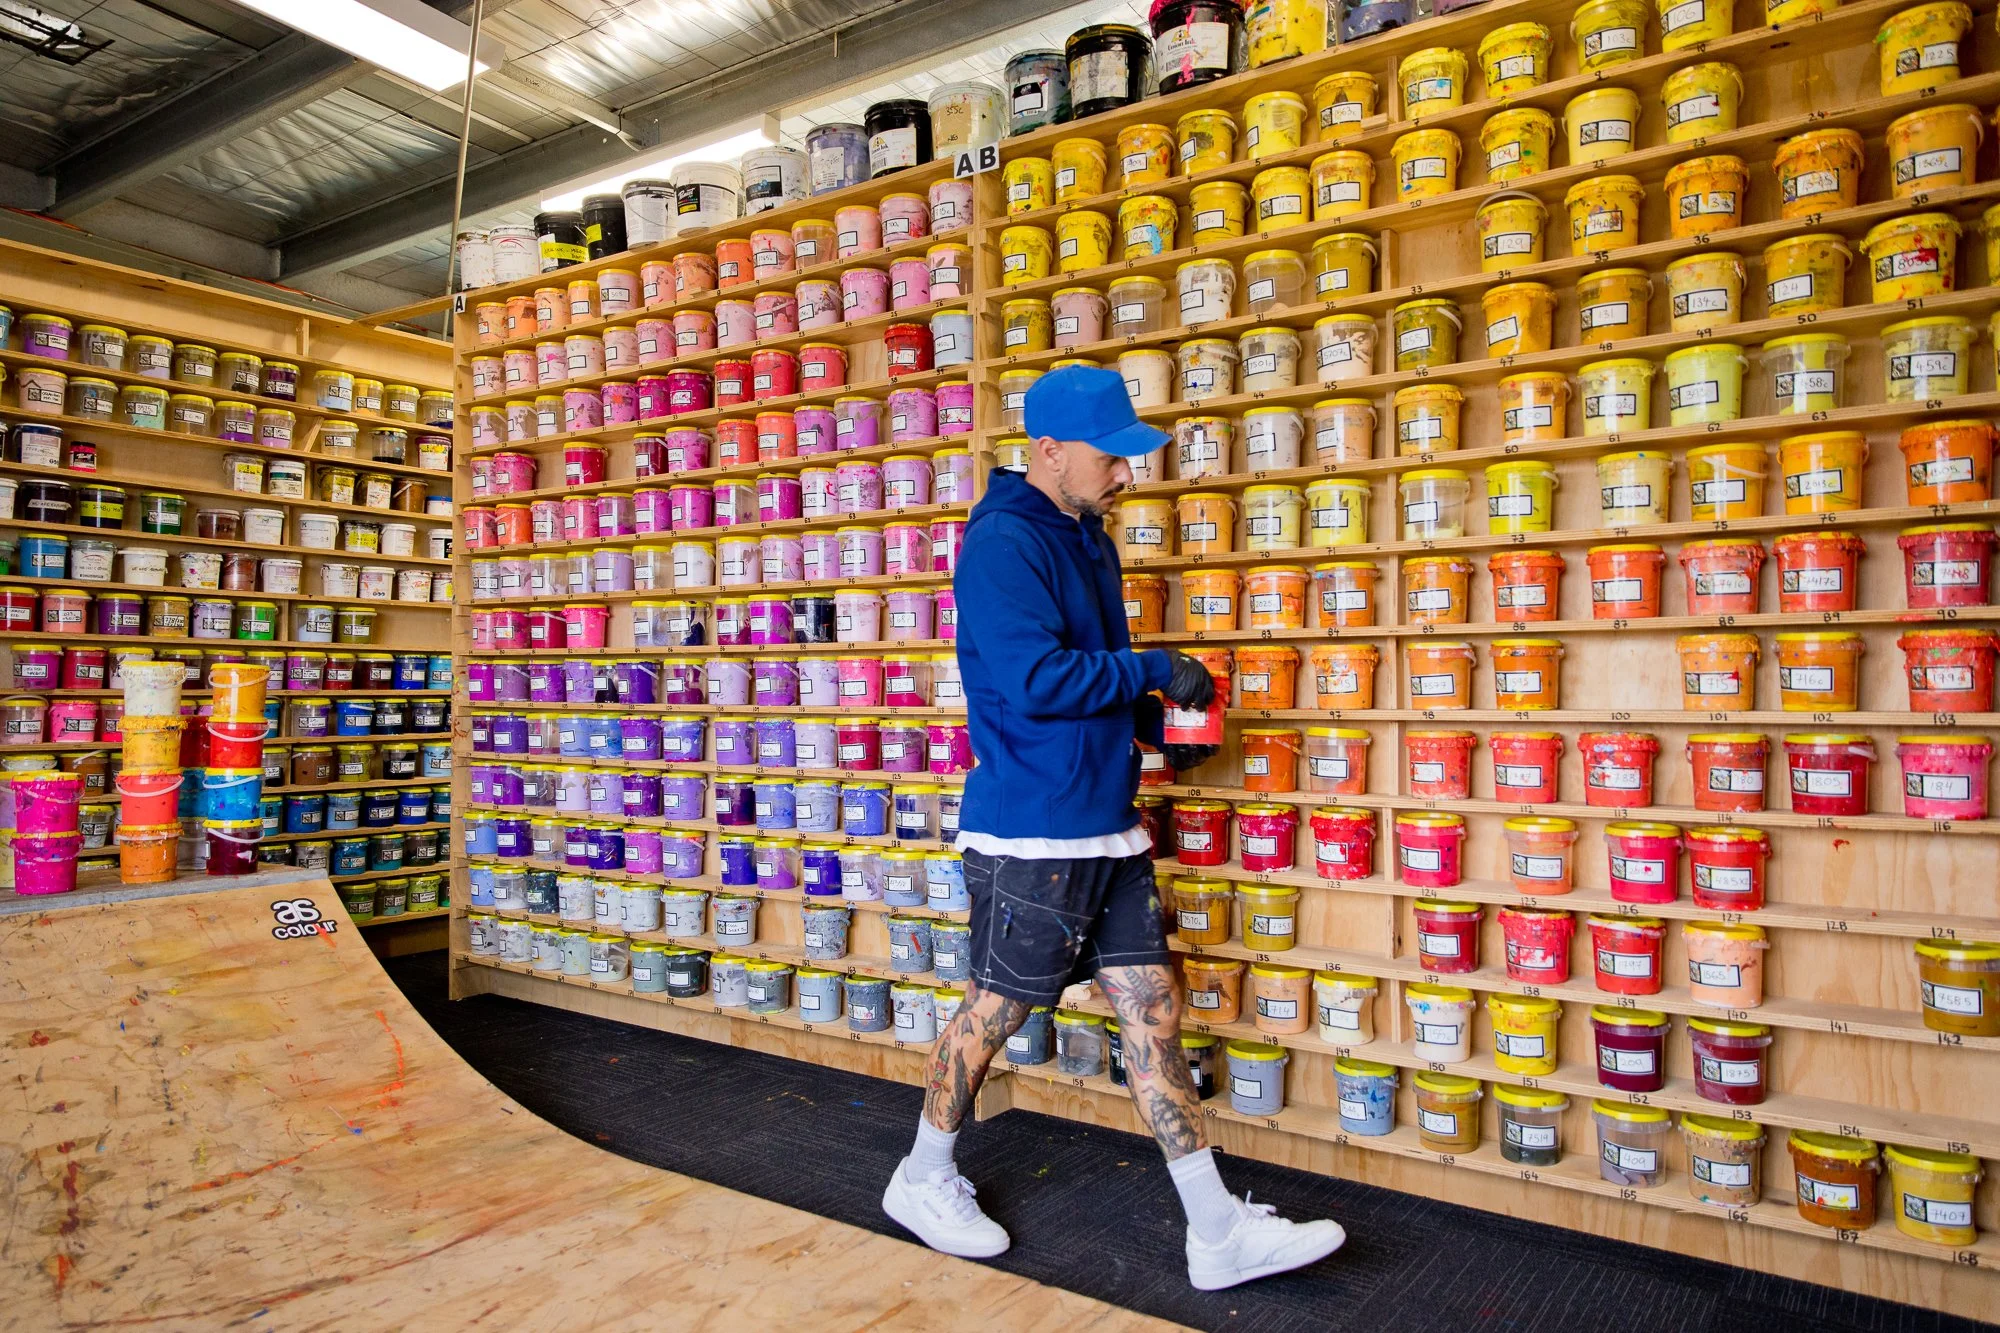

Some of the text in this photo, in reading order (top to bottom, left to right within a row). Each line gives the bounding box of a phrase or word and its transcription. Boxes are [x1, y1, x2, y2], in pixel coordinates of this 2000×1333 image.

[1815, 13, 1823, 22] 11
[1920, 87, 1936, 98] 25
[1809, 111, 1825, 122] 24
[1602, 125, 1624, 137] 120
[1693, 137, 1706, 147] 23
[980, 146, 996, 170] B
[956, 153, 974, 177] A
[1594, 160, 1606, 168] 22
[1410, 200, 1421, 208] 20
[1912, 194, 1928, 207] 38
[1805, 214, 1821, 226] 37
[1694, 234, 1710, 245] 36
[1594, 252, 1609, 261] 35
[1498, 270, 1511, 278] 34
[1411, 286, 1423, 294] 33
[1776, 283, 1798, 297] 124
[455, 296, 463, 312] A
[1326, 301, 1336, 310] 32
[1692, 297, 1718, 308] 134c
[1907, 299, 1923, 310] 51
[1797, 313, 1817, 324] 50
[1696, 328, 1712, 338] 49
[1599, 343, 1613, 351] 48
[1500, 357, 1514, 366] 47
[1416, 369, 1428, 377] 46
[1324, 381, 1338, 390] 45
[1926, 400, 1943, 409] 64
[1812, 412, 1828, 421] 63
[1707, 423, 1720, 432] 62
[1505, 445, 1519, 454] 60
[1421, 455, 1434, 463] 59
[1324, 465, 1337, 473] 58
[1931, 504, 1950, 516] 77
[1819, 513, 1836, 523] 76
[1712, 521, 1728, 530] 75
[1614, 528, 1628, 537] 74
[1512, 535, 1525, 543] 73
[1421, 541, 1435, 549] 72
[1326, 547, 1336, 555] 71
[1823, 613, 1840, 623] 89
[1937, 609, 1957, 619] 90
[1614, 620, 1628, 630] 87
[1719, 616, 1735, 626] 88
[1423, 625, 1434, 633] 85
[1513, 622, 1526, 631] 86
[1261, 630, 1272, 639] 83
[1327, 628, 1340, 637] 84
[1706, 678, 1729, 691] 715
[1260, 710, 1271, 718] 96
[1330, 711, 1342, 720] 97
[1422, 711, 1435, 720] 98
[1516, 711, 1529, 720] 99
[1611, 711, 1630, 721] 100
[1710, 712, 1728, 722] 101
[1813, 713, 1834, 722] 102
[1934, 714, 1956, 725] 103
[1187, 789, 1201, 797] 108
[1255, 792, 1268, 800] 109
[1325, 796, 1337, 804] 110
[1520, 805, 1534, 813] 112
[1613, 808, 1628, 818] 113
[1717, 814, 1733, 824] 114
[1818, 817, 1833, 827] 115
[1934, 821, 1951, 832] 116
[1187, 867, 1198, 875] 121
[1256, 874, 1270, 882] 122
[1327, 880, 1341, 889] 123
[1421, 888, 1437, 898] 124
[1520, 897, 1537, 906] 125
[271, 898, 321, 924] as
[1617, 904, 1638, 915] 126
[1722, 913, 1743, 923] 127
[1826, 921, 1848, 931] 128
[1932, 926, 1955, 938] 129
[1191, 945, 1203, 954] 134
[1256, 953, 1270, 962] 135
[801, 959, 811, 967] 162
[1325, 962, 1341, 971] 136
[847, 966, 857, 975] 163
[900, 974, 910, 982] 164
[1424, 975, 1440, 983] 137
[941, 980, 952, 989] 165
[1523, 986, 1540, 996] 138
[666, 997, 675, 1005] 172
[1617, 997, 1635, 1008] 139
[1937, 993, 1972, 1007] 7585
[1727, 1010, 1747, 1020] 140
[803, 1023, 813, 1032] 175
[1197, 1024, 1210, 1033] 147
[1830, 1021, 1847, 1033] 141
[1263, 1035, 1278, 1045] 148
[1938, 1032, 1963, 1046] 142
[1336, 1047, 1350, 1058] 149
[1428, 1062, 1445, 1072] 150
[1072, 1077, 1084, 1087] 158
[1523, 1077, 1539, 1088] 151
[1629, 1094, 1649, 1105] 152
[1201, 1106, 1217, 1117] 160
[1733, 1109, 1752, 1120] 153
[1267, 1120, 1279, 1130] 161
[1839, 1125, 1862, 1137] 154
[1336, 1134, 1349, 1144] 162
[1527, 1133, 1549, 1144] 7519
[1947, 1142, 1970, 1153] 155
[1439, 1154, 1455, 1165] 163
[1624, 1152, 1646, 1167] 409
[1520, 1170, 1538, 1181] 164
[1620, 1189, 1637, 1200] 165
[1728, 1209, 1749, 1222] 166
[1930, 1208, 1966, 1222] 7407
[1836, 1229, 1859, 1243] 167
[1952, 1251, 1978, 1265] 168
